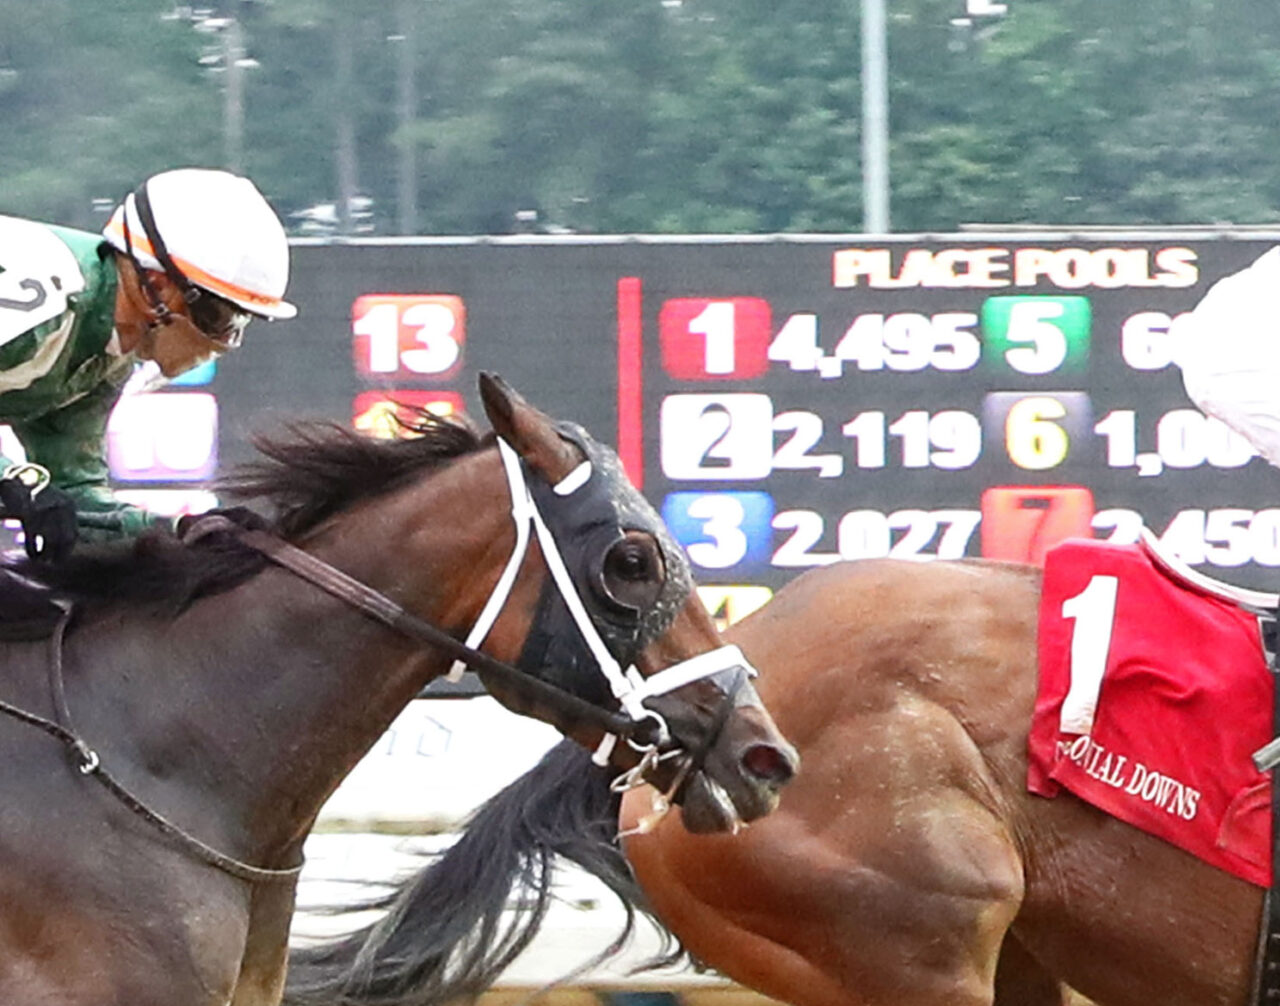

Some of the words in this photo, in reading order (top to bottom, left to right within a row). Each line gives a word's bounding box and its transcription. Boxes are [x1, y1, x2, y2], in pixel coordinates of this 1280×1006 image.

[832, 248, 1011, 289] PLACE
[1014, 248, 1199, 289] POOLS
[353, 303, 459, 374] 13
[687, 302, 736, 374] 1
[767, 313, 982, 379] 4,495
[1004, 301, 1068, 374] 5
[697, 401, 734, 470] 2
[771, 409, 982, 478] 2,119
[1005, 396, 1070, 471] 6
[1093, 410, 1262, 478] 1,00
[686, 494, 748, 568] 3
[1058, 574, 1119, 735] 1
[1125, 763, 1201, 821] DOWNS
